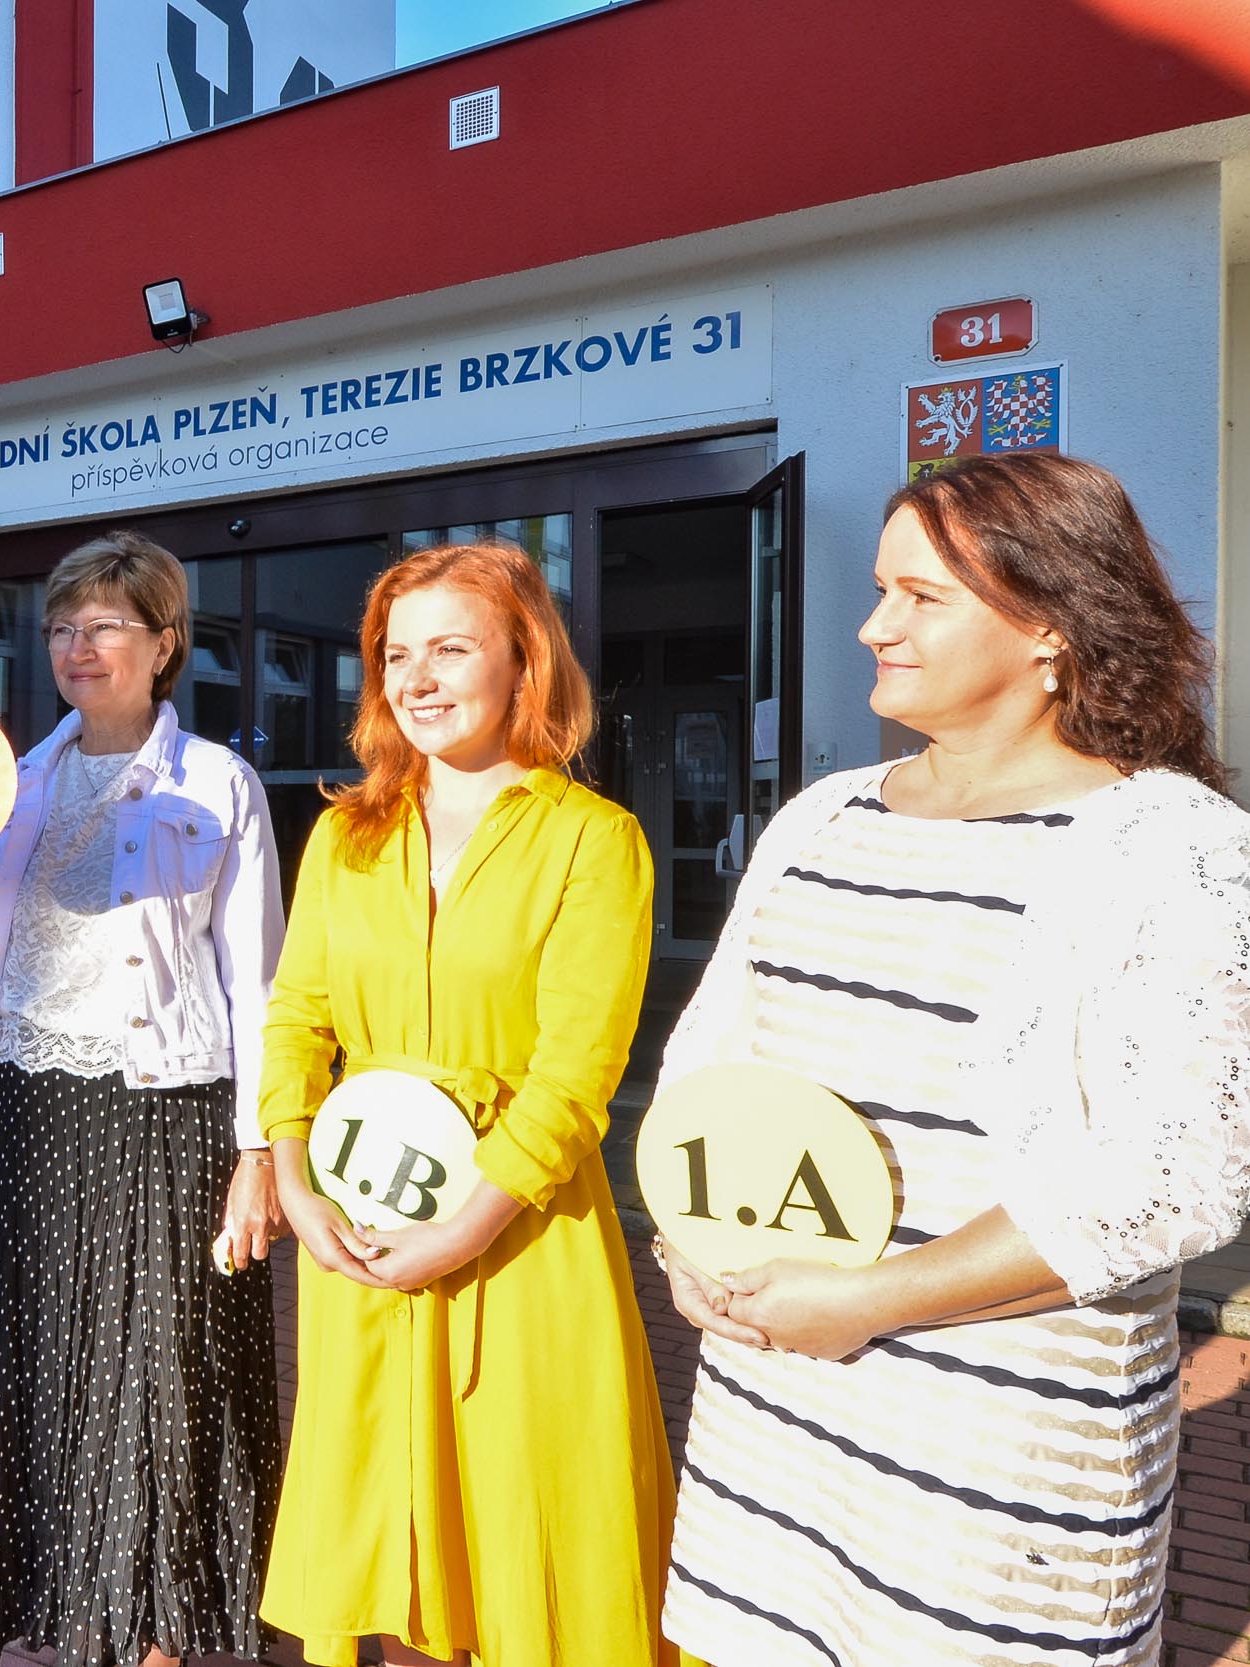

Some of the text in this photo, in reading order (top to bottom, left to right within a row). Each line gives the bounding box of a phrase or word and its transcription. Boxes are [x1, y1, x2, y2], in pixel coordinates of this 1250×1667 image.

[959, 312, 1004, 348] 31
[61, 414, 161, 458] ŠKOLA
[174, 385, 290, 440] PLZEŇ,
[300, 363, 442, 419] TEREZIE
[459, 313, 672, 393] BRZKOVÉ
[692, 311, 741, 355] 31
[71, 425, 389, 498] příspěvková organizace
[324, 1118, 447, 1222] 1.B
[673, 1136, 860, 1243] 1.A
